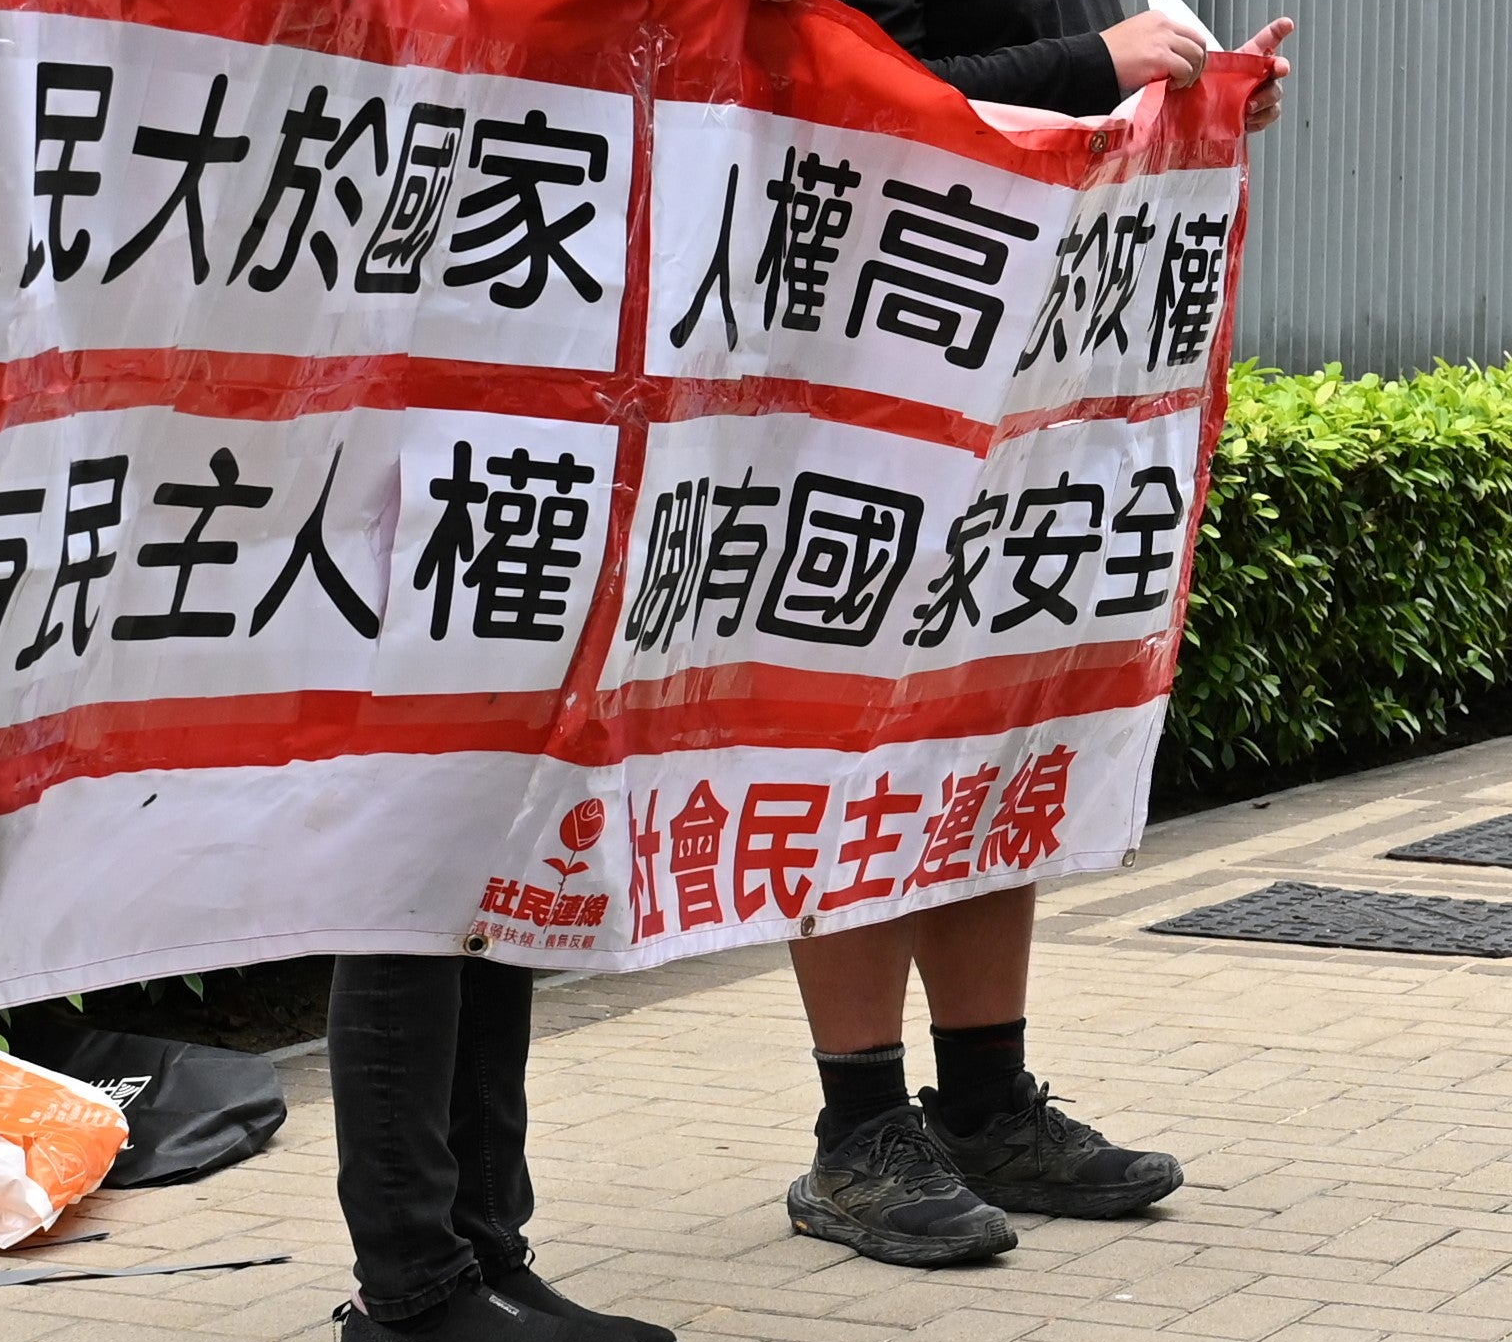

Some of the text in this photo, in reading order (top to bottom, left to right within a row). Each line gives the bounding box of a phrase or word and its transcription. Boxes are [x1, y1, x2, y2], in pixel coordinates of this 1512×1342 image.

[670, 146, 1228, 377] 人權高於政權
[625, 465, 1183, 655] 哪有國家安全
[479, 876, 609, 927] 社民連線
[627, 742, 1075, 945] 社會民主連線
